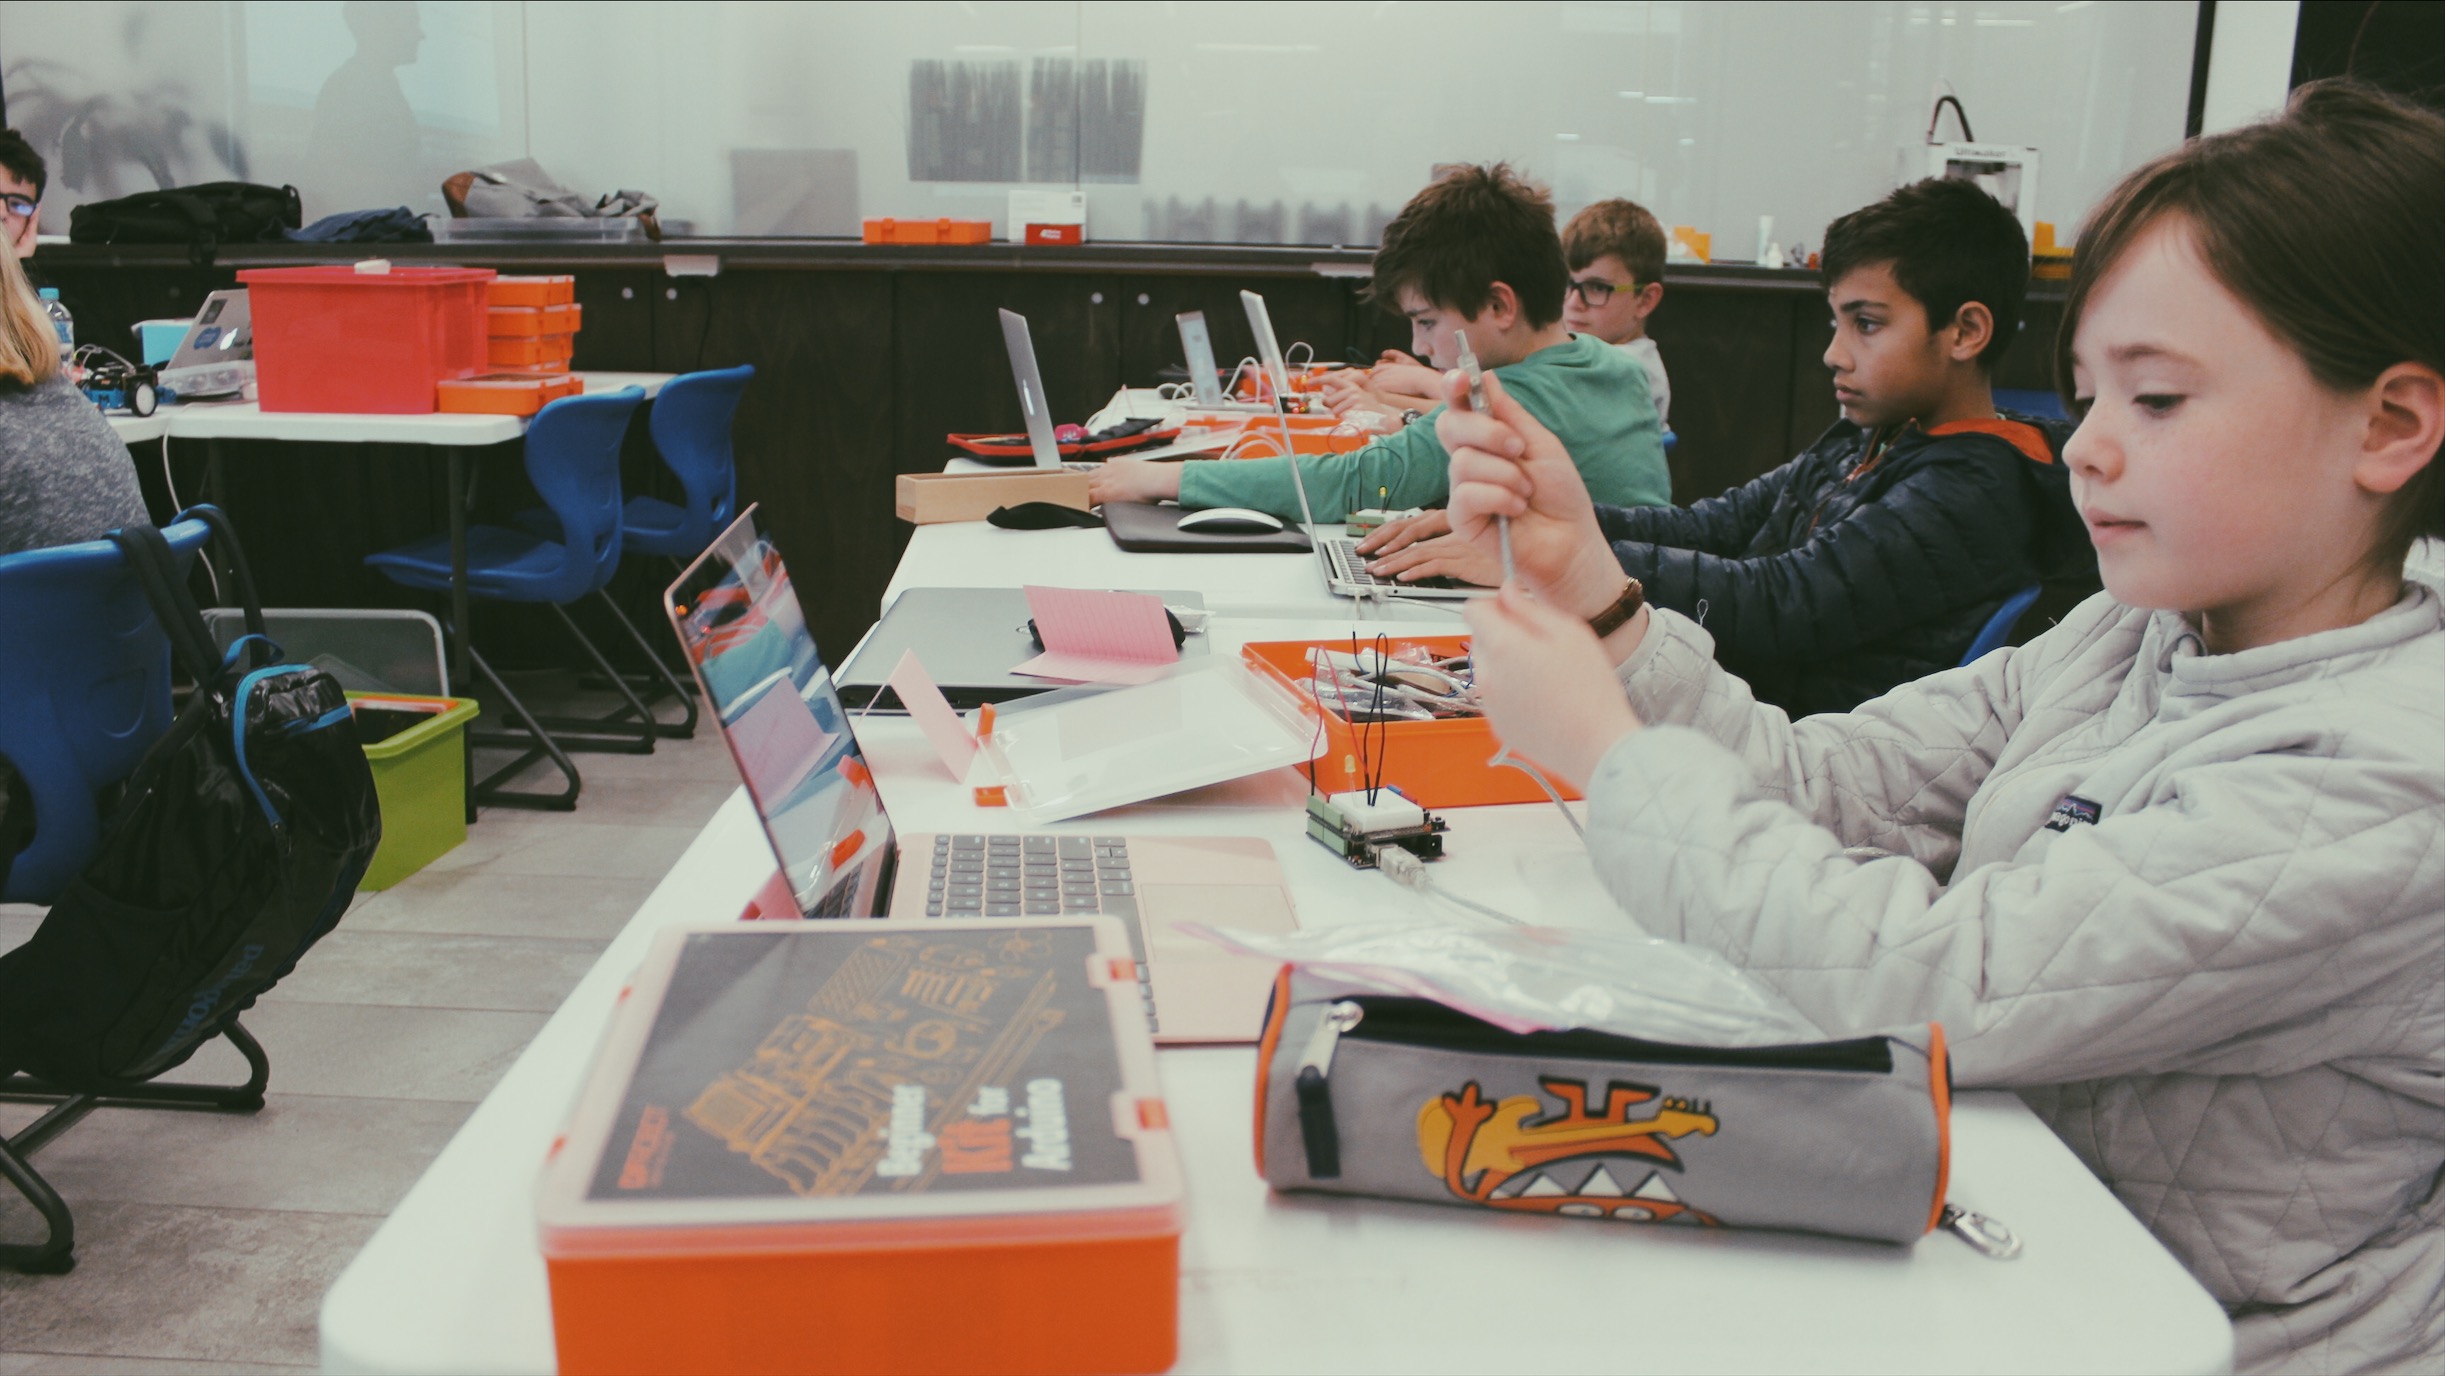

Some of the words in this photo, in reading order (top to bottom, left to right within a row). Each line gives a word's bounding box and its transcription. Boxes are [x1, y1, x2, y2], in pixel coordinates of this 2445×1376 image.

[876, 1084, 936, 1177] Beginner
[967, 1086, 1010, 1115] for
[1014, 1078, 1073, 1171] Arduino
